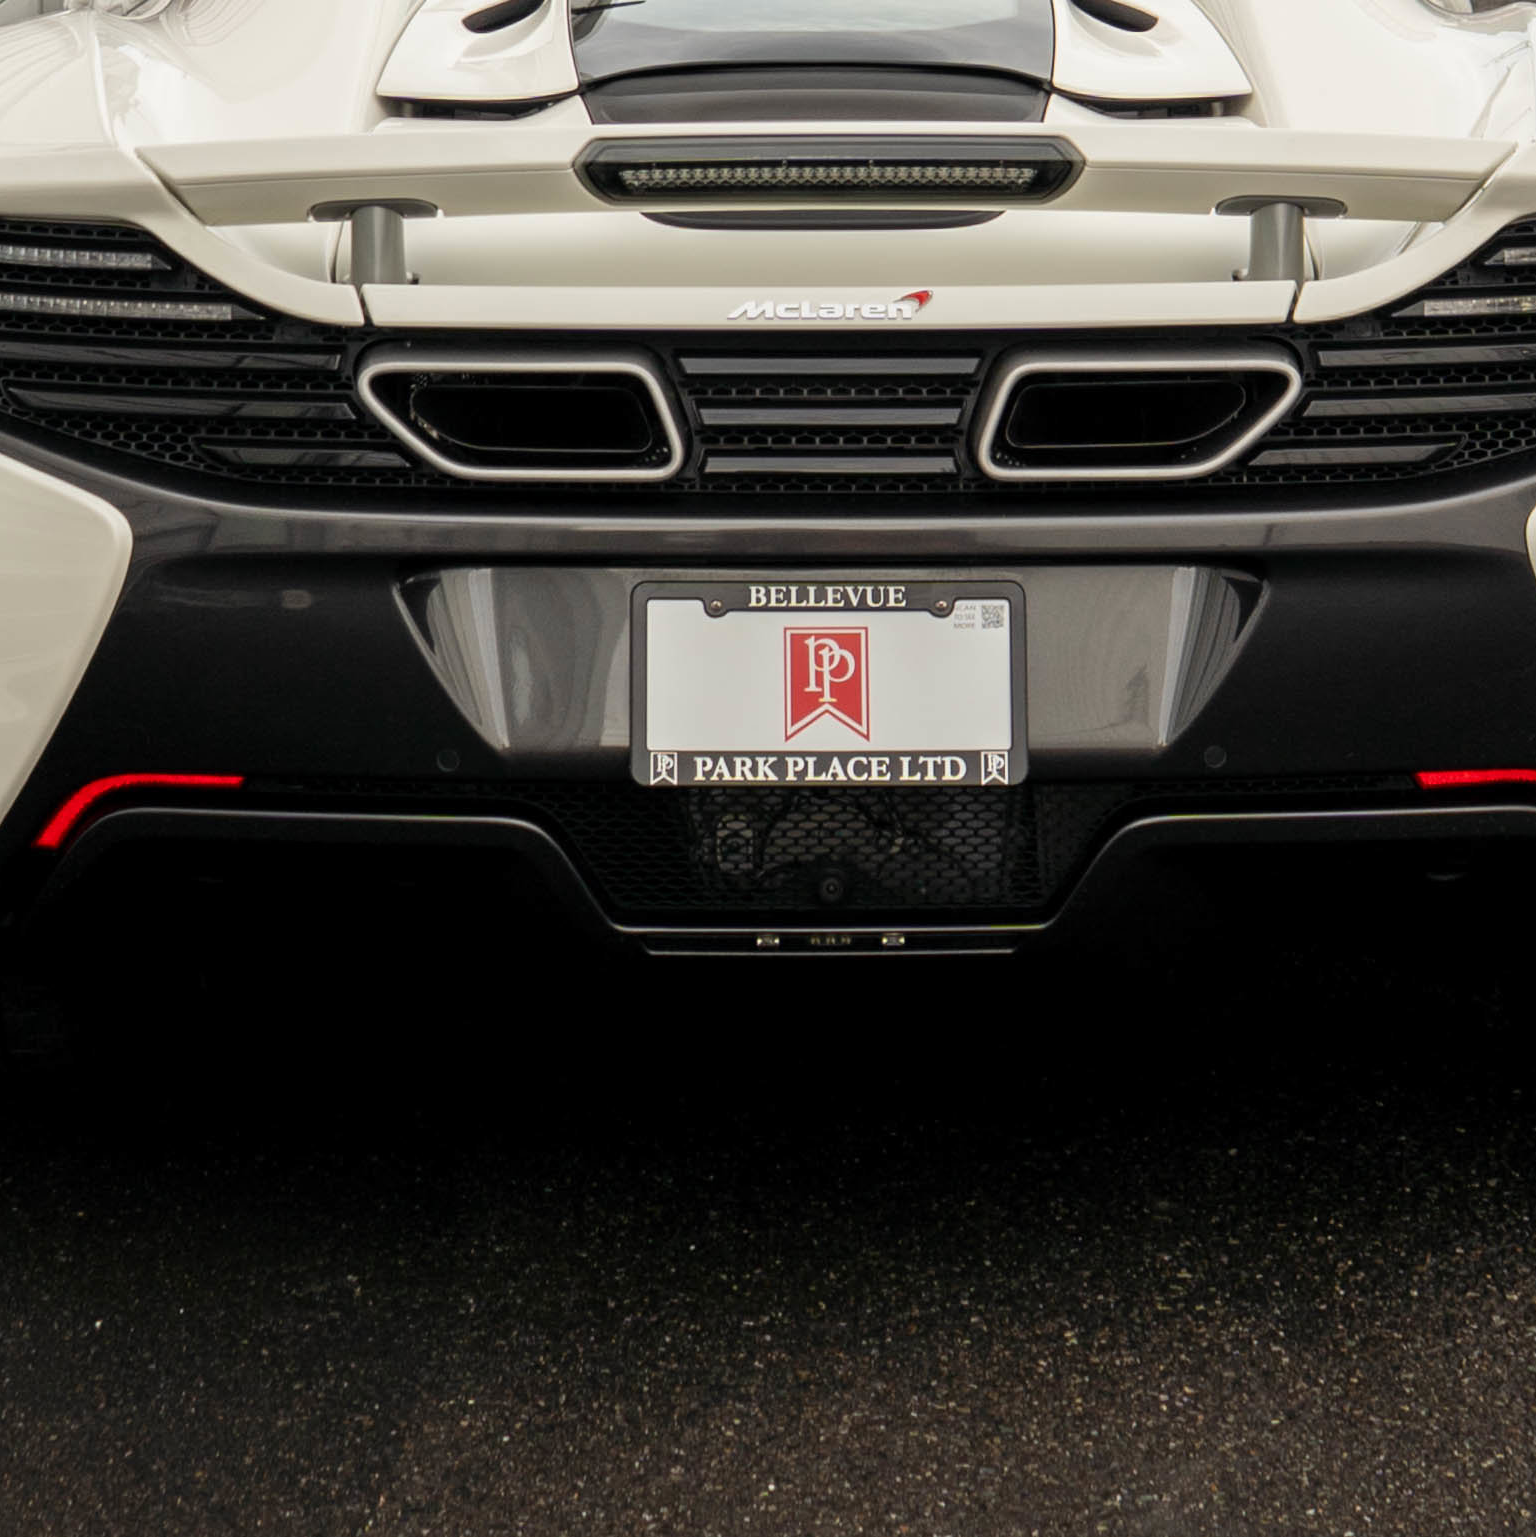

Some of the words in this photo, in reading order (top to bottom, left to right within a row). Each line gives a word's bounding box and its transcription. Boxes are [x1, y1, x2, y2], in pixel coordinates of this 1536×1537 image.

[727, 301, 913, 320] McLaren
[748, 585, 907, 608] BELLEVUE
[693, 756, 779, 782] PARK
[785, 756, 891, 782] PLACE
[899, 756, 967, 782] LTD
